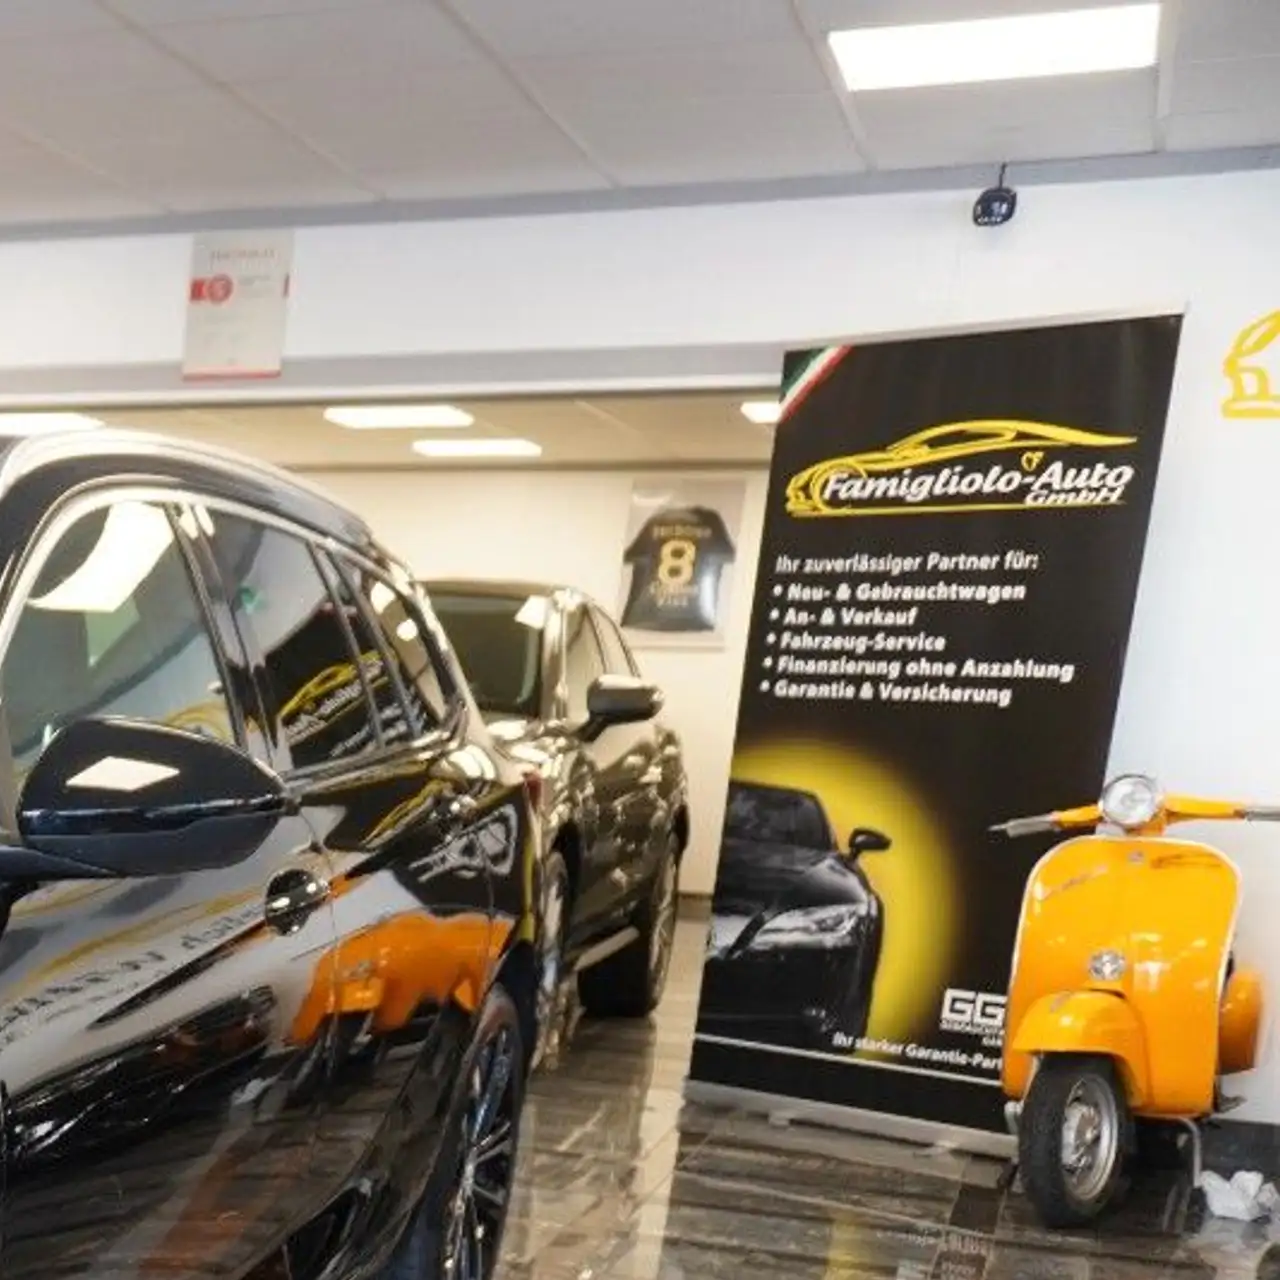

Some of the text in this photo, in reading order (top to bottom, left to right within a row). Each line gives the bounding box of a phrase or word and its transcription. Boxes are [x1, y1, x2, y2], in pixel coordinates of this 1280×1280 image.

[823, 461, 1134, 502] Famigliolo-Auto
[1024, 485, 1126, 507] GmbH
[658, 539, 696, 585] 8
[775, 550, 1039, 576] Ihr zuverlässiger Partner für:
[788, 581, 1027, 605] Neu- & Gebrauchtwagen
[783, 607, 918, 626] An- & Verkauf
[780, 631, 947, 654] Fahrzeug-Service
[777, 656, 1075, 683] Finanzierung ohne Anzahlung
[774, 680, 1013, 708] Garantie & Versicherung
[832, 1031, 854, 1047] Ihr
[855, 1037, 905, 1054] starker
